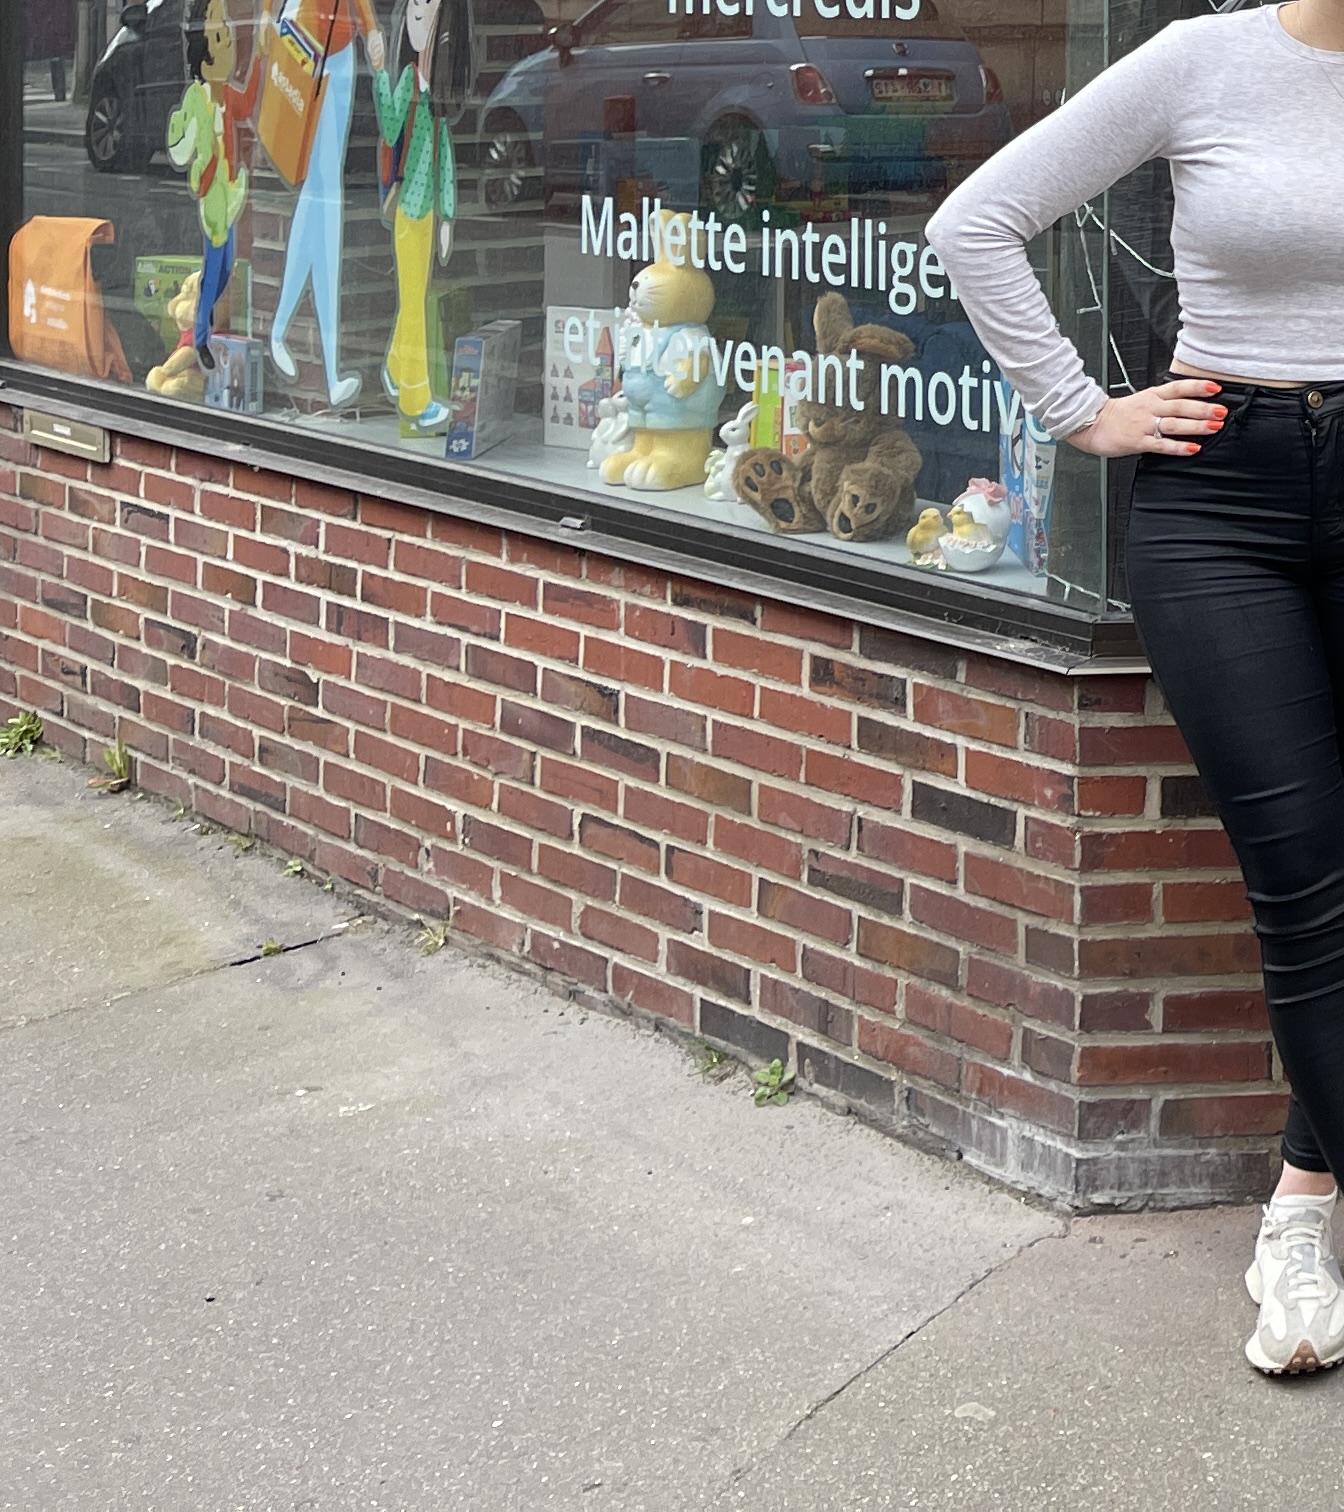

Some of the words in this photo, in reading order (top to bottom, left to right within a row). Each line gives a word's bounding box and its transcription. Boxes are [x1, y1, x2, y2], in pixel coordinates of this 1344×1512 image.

[581, 194, 746, 274] Mallette
[563, 311, 600, 366] et
[613, 307, 865, 411] intervenant
